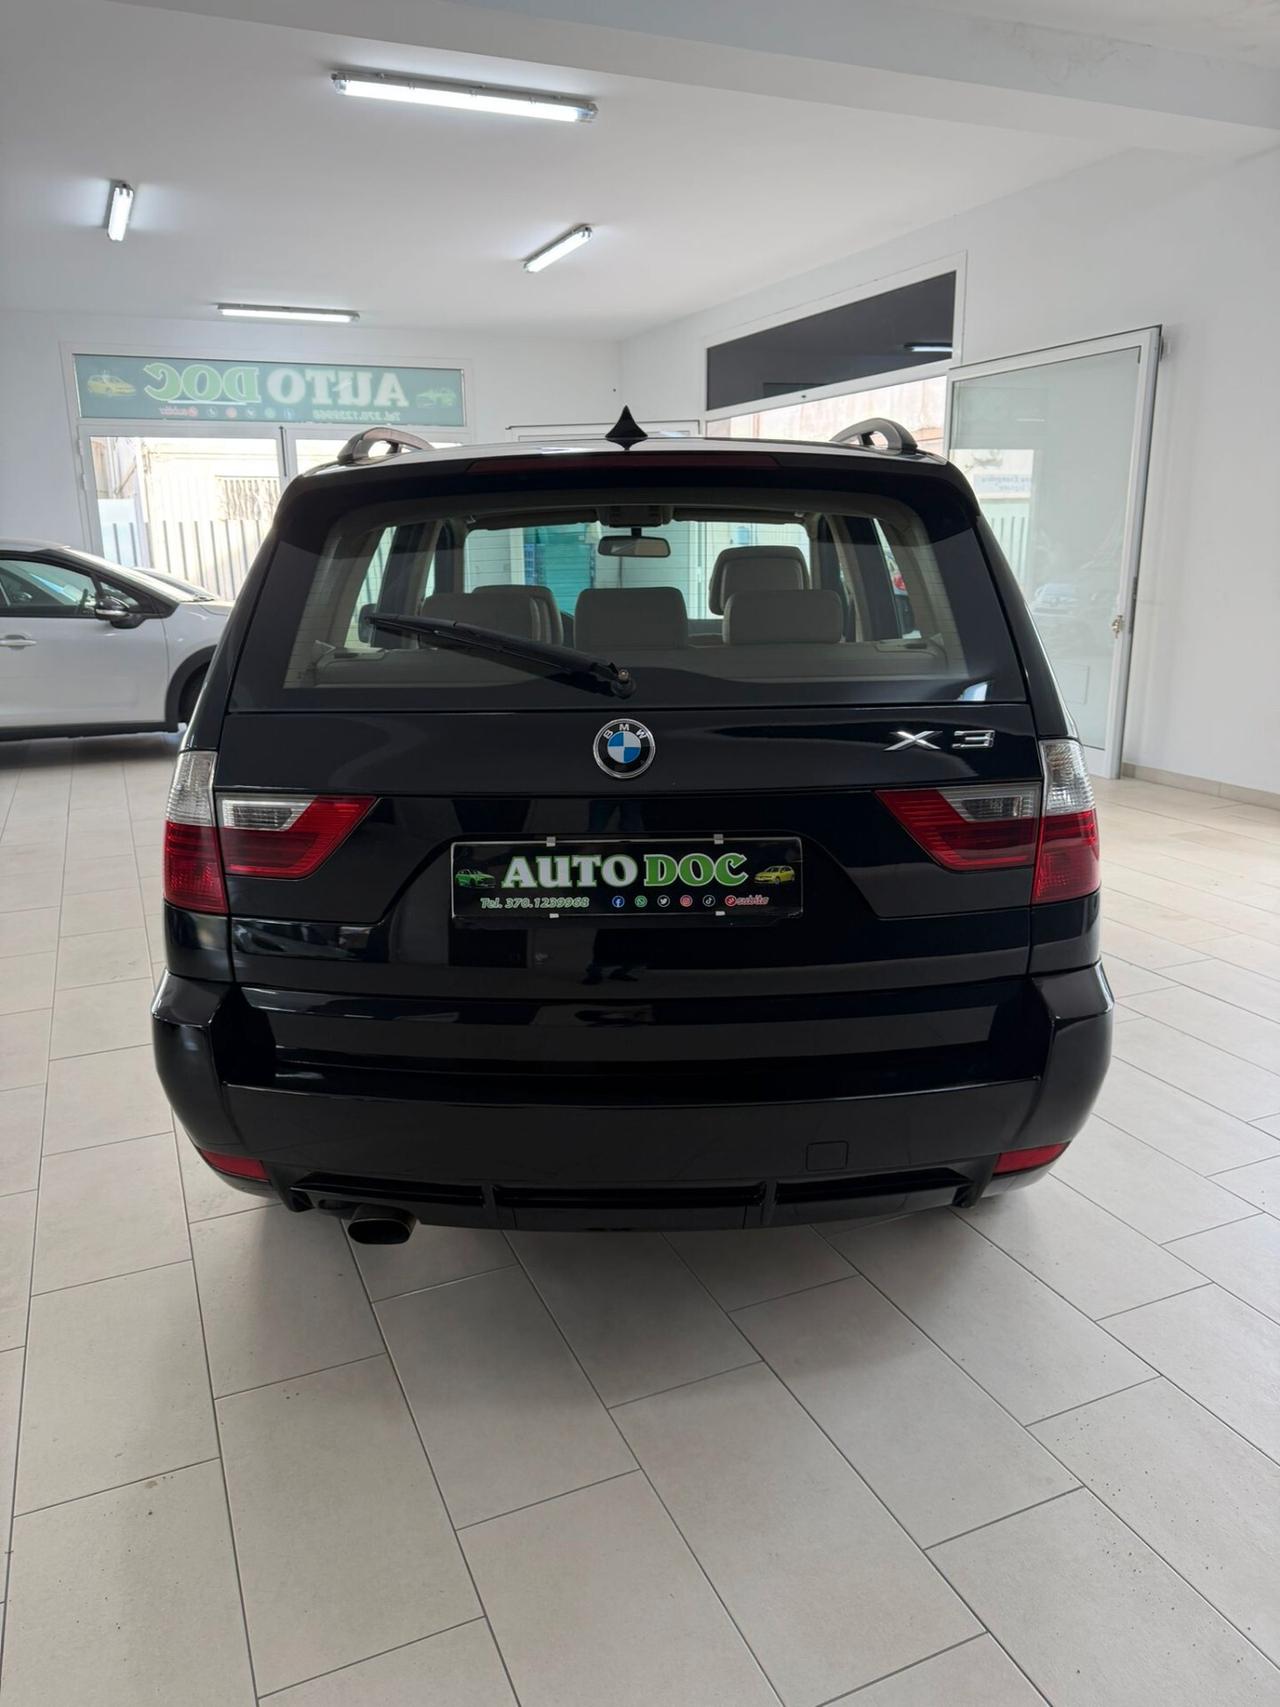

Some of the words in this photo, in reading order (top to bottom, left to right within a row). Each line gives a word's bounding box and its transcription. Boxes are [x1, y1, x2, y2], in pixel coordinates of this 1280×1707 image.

[603, 723, 647, 739] BMW
[501, 853, 638, 889] AUTO
[643, 852, 748, 887] DOC
[480, 897, 502, 909] Tel.
[505, 896, 590, 909] 370.1239968
